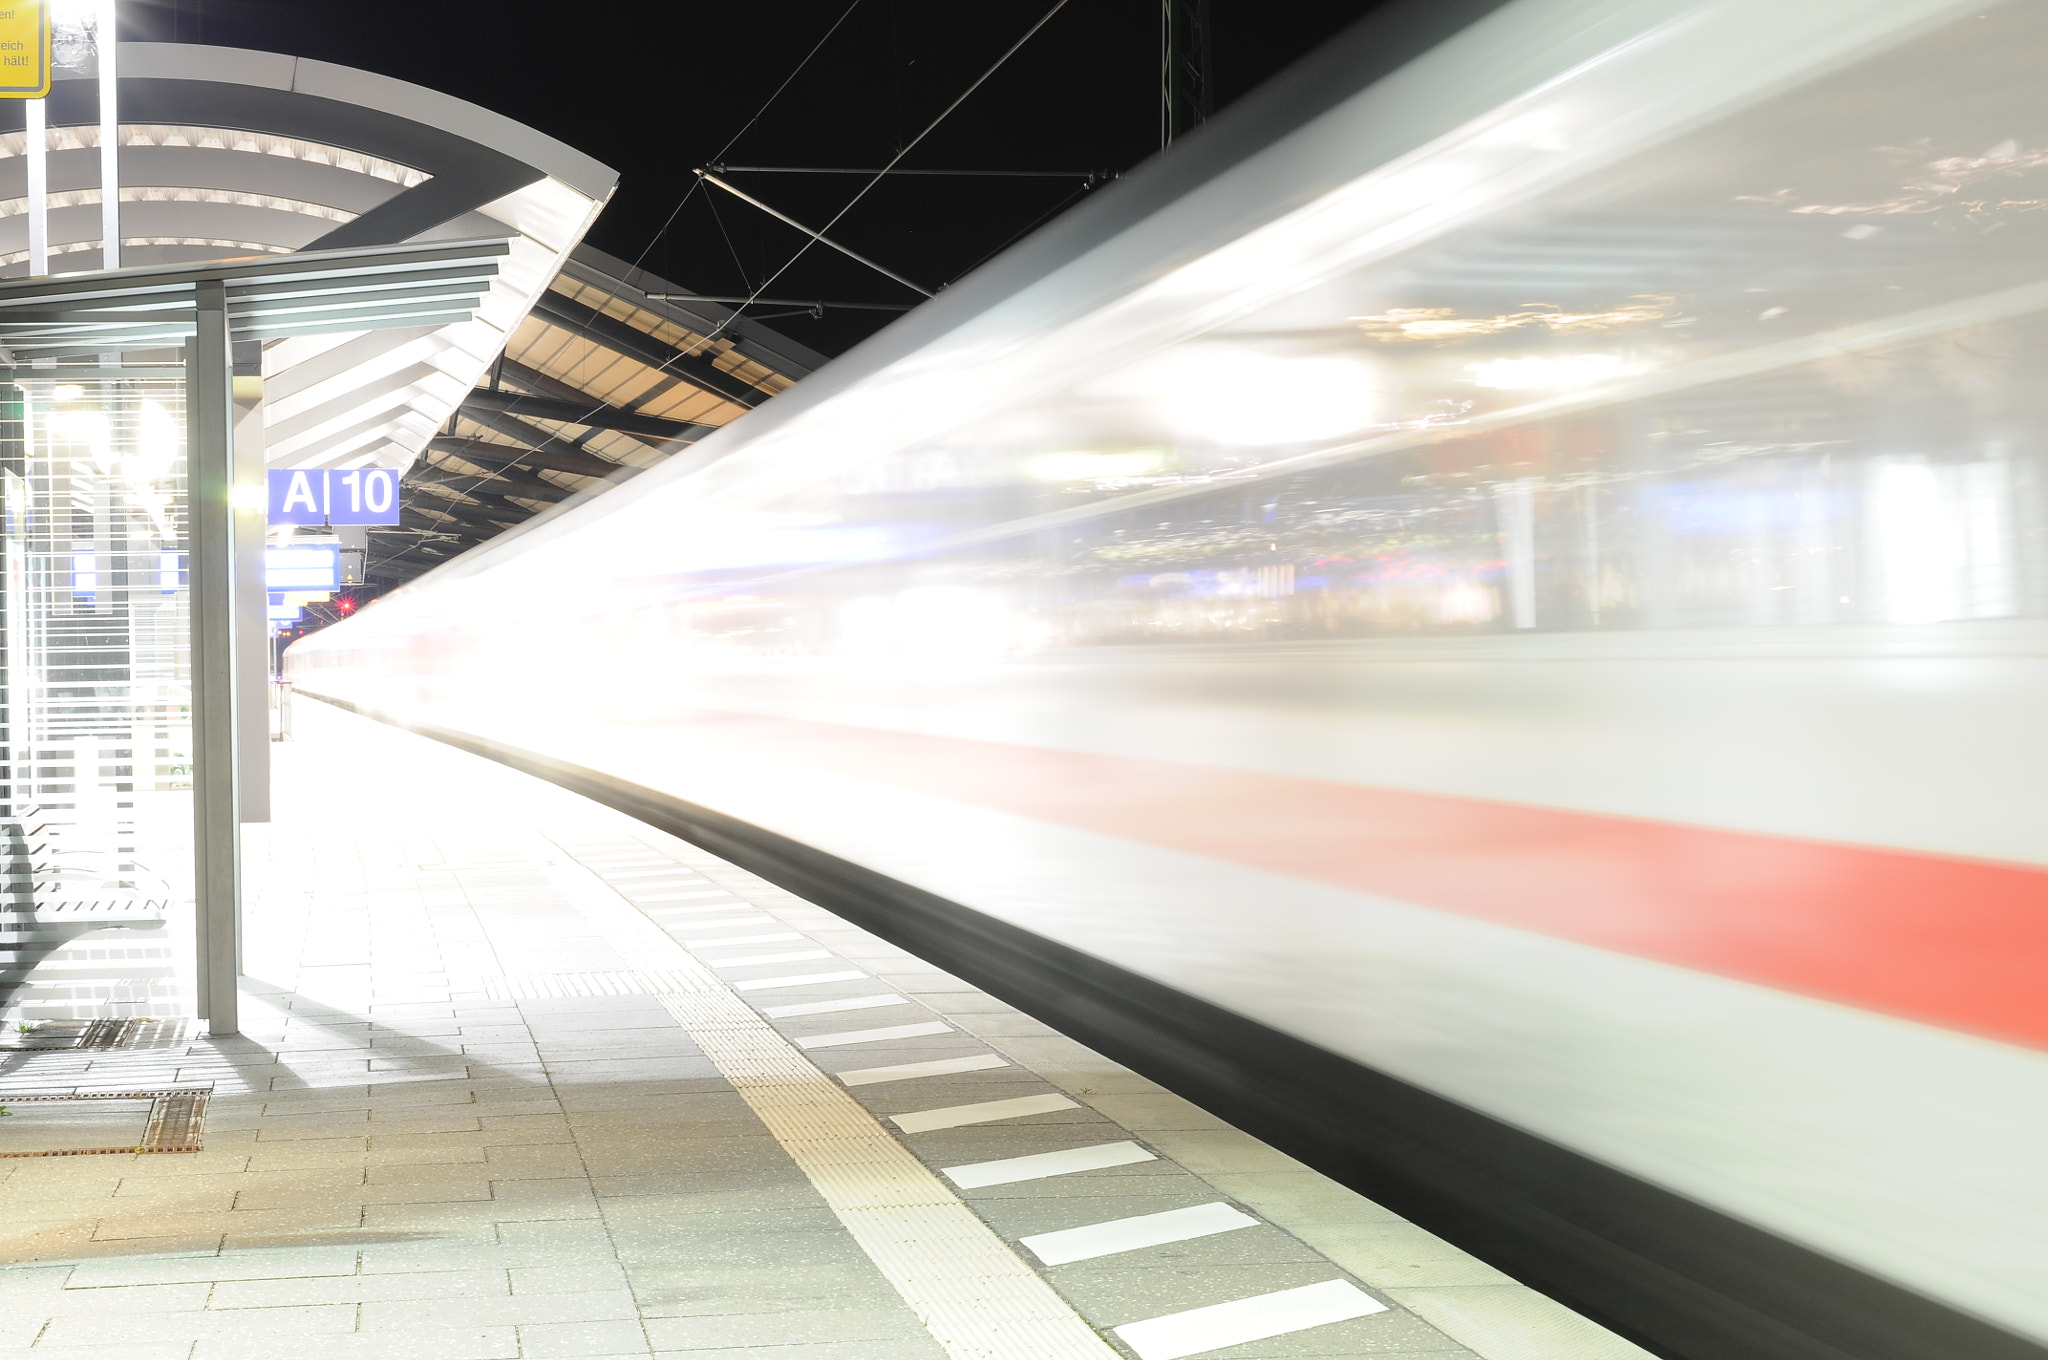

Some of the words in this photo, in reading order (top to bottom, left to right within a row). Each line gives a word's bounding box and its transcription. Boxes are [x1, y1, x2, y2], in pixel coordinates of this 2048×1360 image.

[0, 40, 24, 51] eich
[4, 55, 29, 66] hält!
[282, 471, 317, 513] A
[341, 470, 393, 513] 10
